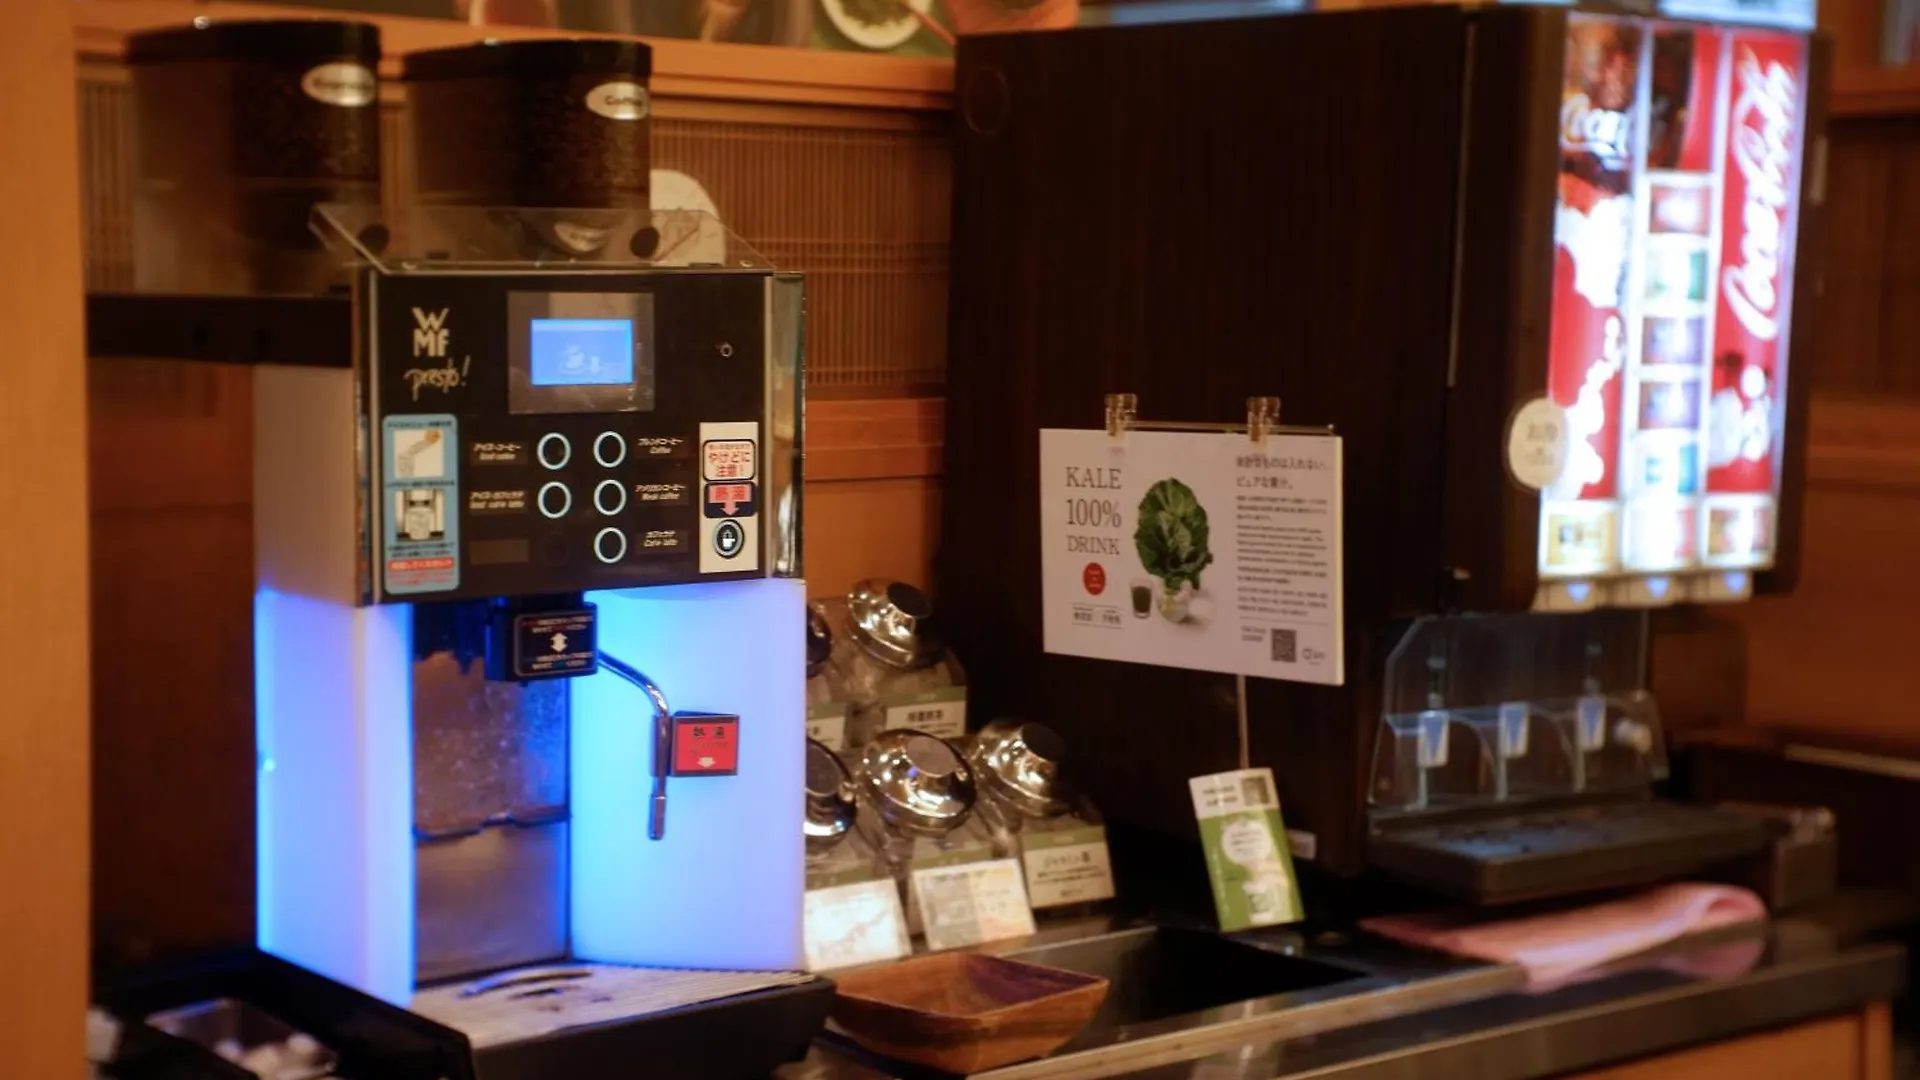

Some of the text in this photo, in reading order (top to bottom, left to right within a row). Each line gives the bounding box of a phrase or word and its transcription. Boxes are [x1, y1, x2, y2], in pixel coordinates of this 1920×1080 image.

[1065, 466, 1122, 490] KALE
[1066, 498, 1122, 528] 100%
[1066, 534, 1120, 556] DRINK
